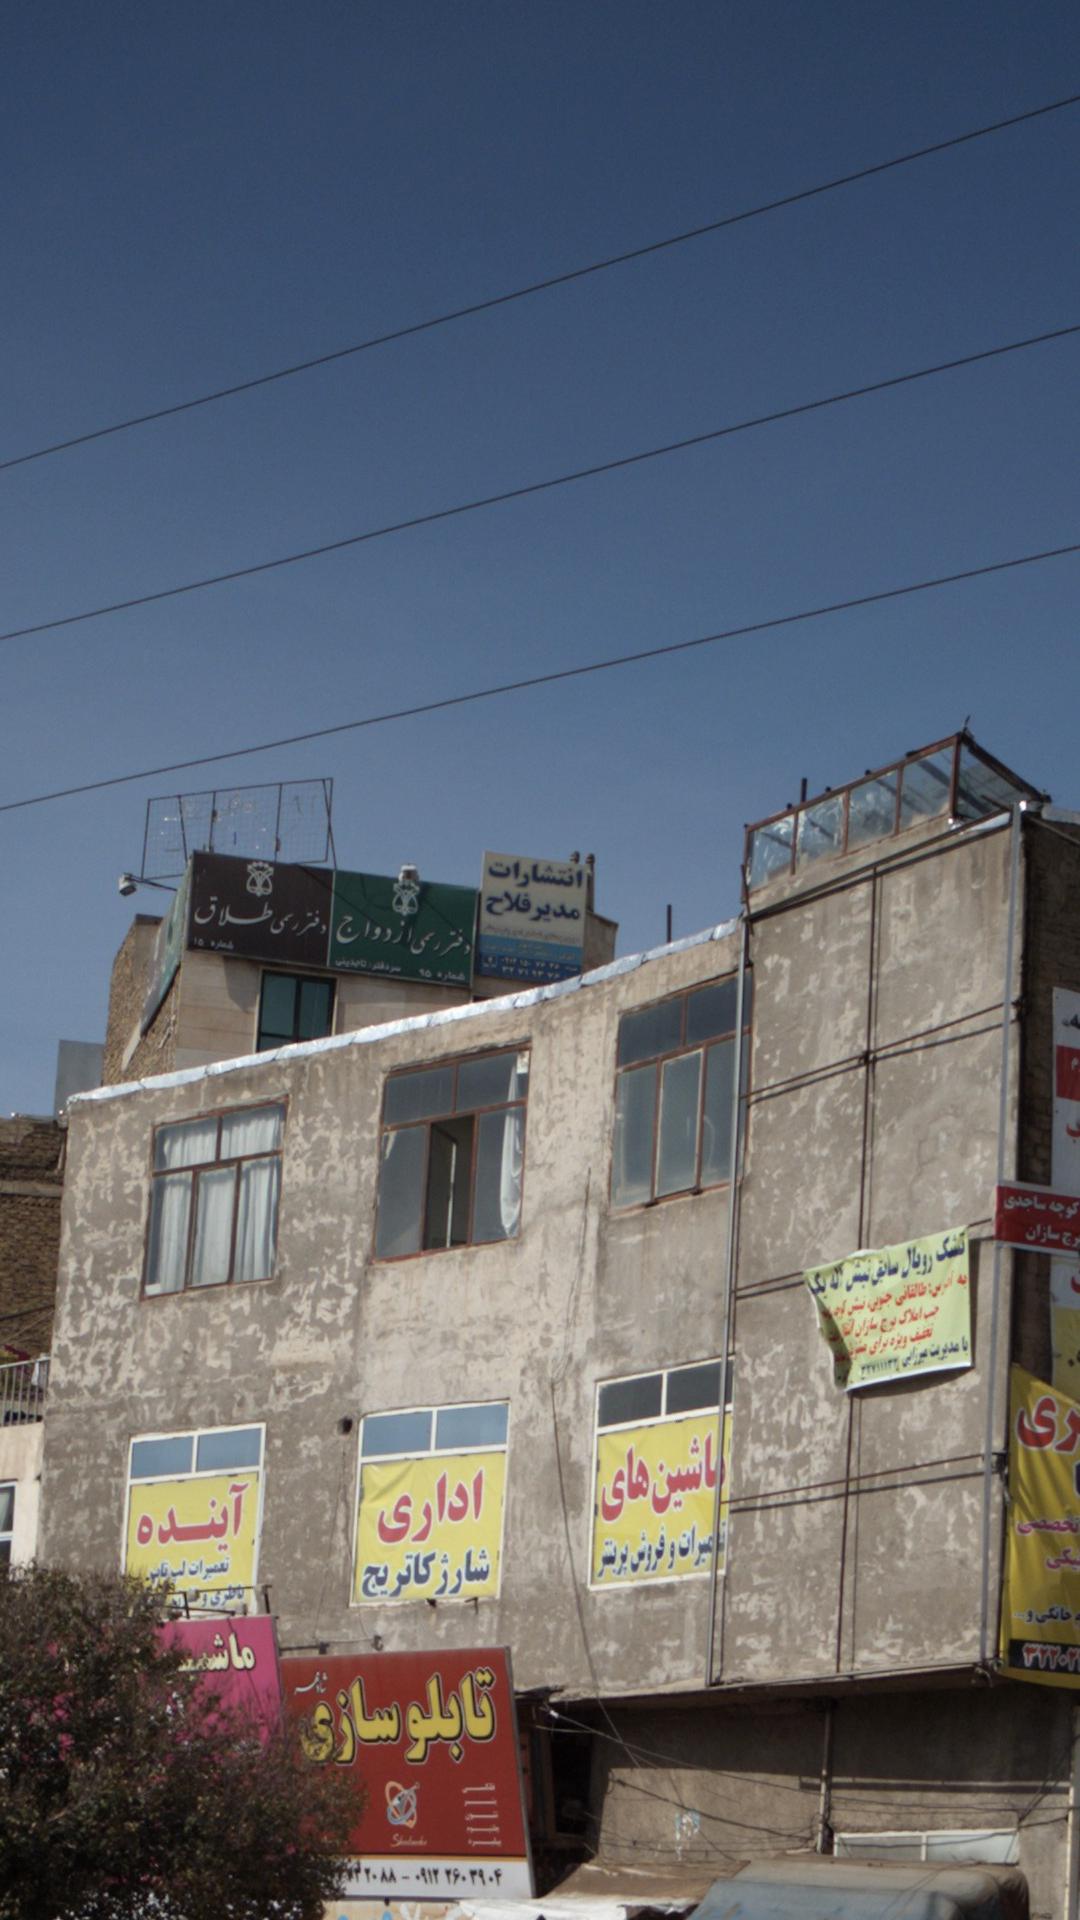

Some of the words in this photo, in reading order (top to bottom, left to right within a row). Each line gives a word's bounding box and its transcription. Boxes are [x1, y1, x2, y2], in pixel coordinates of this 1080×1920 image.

[488, 861, 583, 888] انتشارات
[194, 896, 273, 927] طلاق
[486, 891, 531, 915] فلاح
[530, 904, 580, 922] مدیر
[270, 912, 298, 935] رسمی
[297, 909, 327, 936] دفتر
[336, 915, 413, 944] ازدواج
[410, 931, 441, 955] رسمی
[440, 928, 471, 957] دفتر
[601, 1446, 649, 1522] های
[136, 1483, 249, 1552] آینده
[377, 1469, 483, 1543] اداری
[630, 1527, 666, 1572] فروش
[434, 1549, 489, 1595] شارژ
[301, 1676, 401, 1766] سازی
[403, 1667, 496, 1764] تابلو
